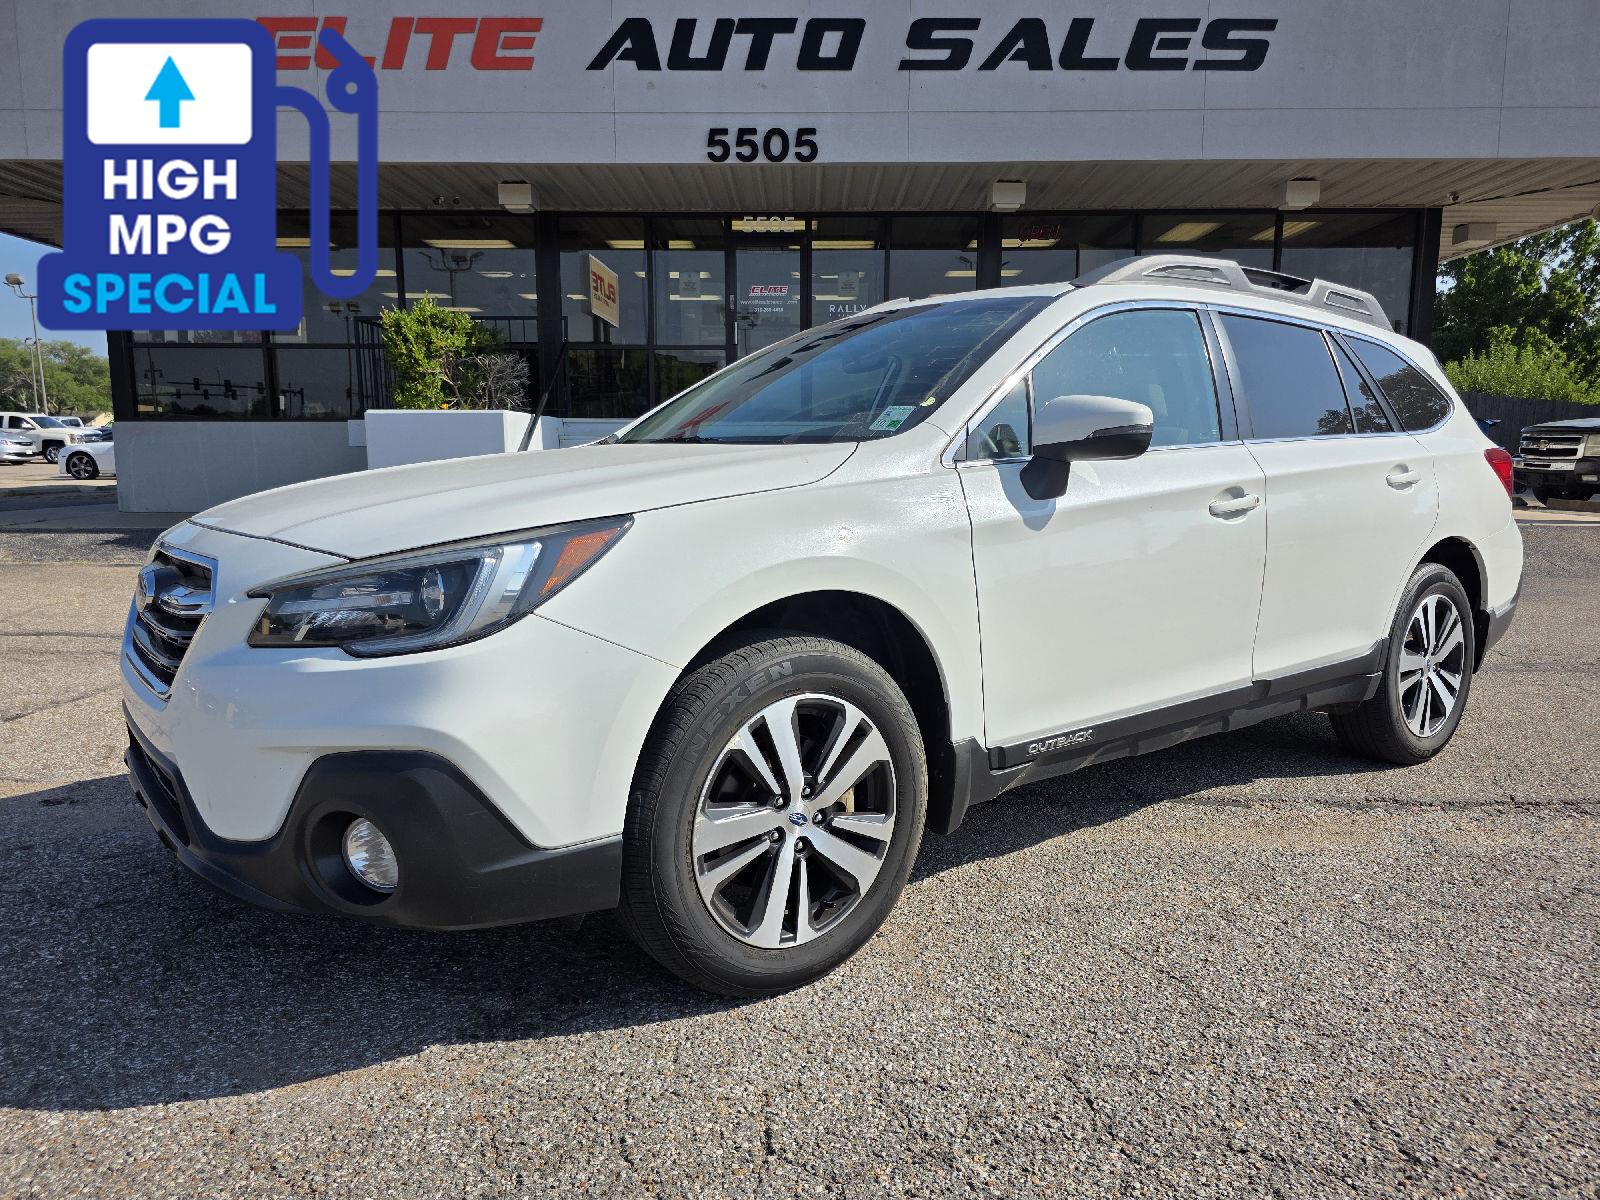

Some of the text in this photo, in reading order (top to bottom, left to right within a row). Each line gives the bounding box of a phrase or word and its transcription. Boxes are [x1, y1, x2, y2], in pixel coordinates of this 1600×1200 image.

[256, 17, 1279, 71] ELITE AUTO SALES
[706, 127, 819, 163] 5505
[742, 216, 795, 232] 5505
[750, 285, 789, 295] ELITE
[829, 304, 867, 313] RALLY
[682, 661, 793, 765] NEXEN
[1027, 729, 1094, 756] OUTBACK
